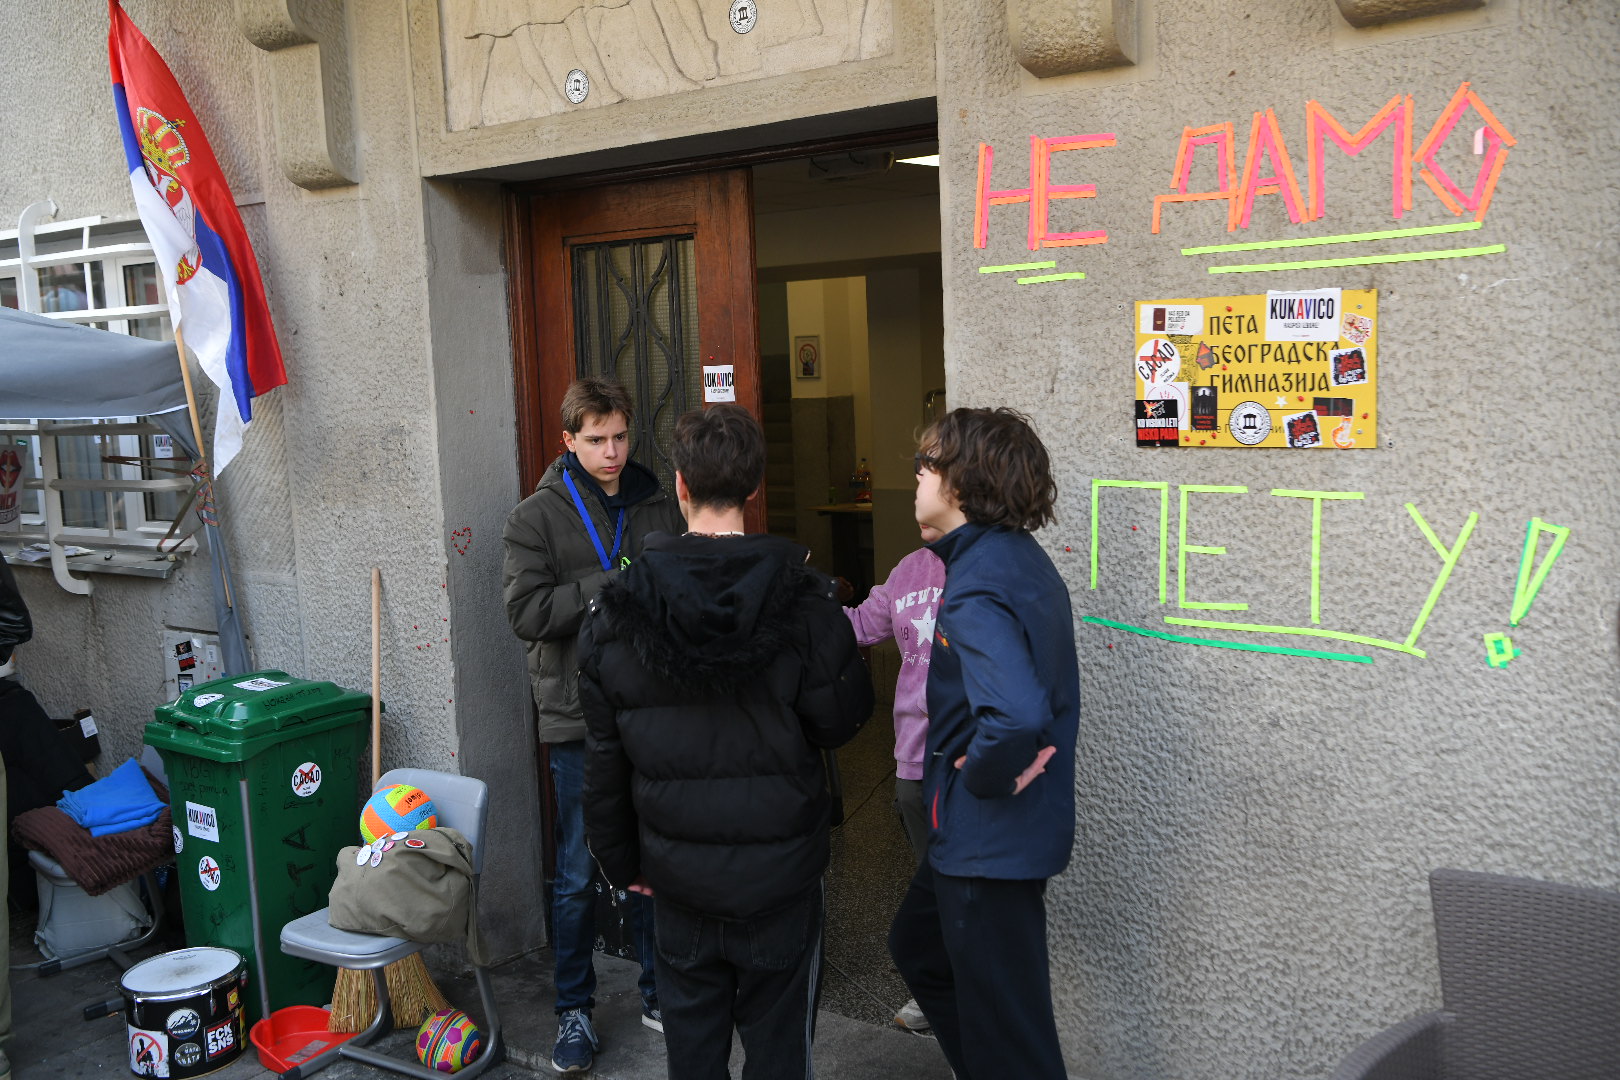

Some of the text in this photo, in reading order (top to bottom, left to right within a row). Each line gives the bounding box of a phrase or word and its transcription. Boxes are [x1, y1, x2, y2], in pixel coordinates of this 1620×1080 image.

[973, 132, 1117, 251] НЕ
[1270, 297, 1335, 320] KUKAVICO
[1209, 315, 1259, 336] ПЕТА
[1210, 372, 1331, 393] ГИМНАЗИЈА
[207, 1021, 233, 1044] FCK
[208, 1033, 234, 1055] SNS
